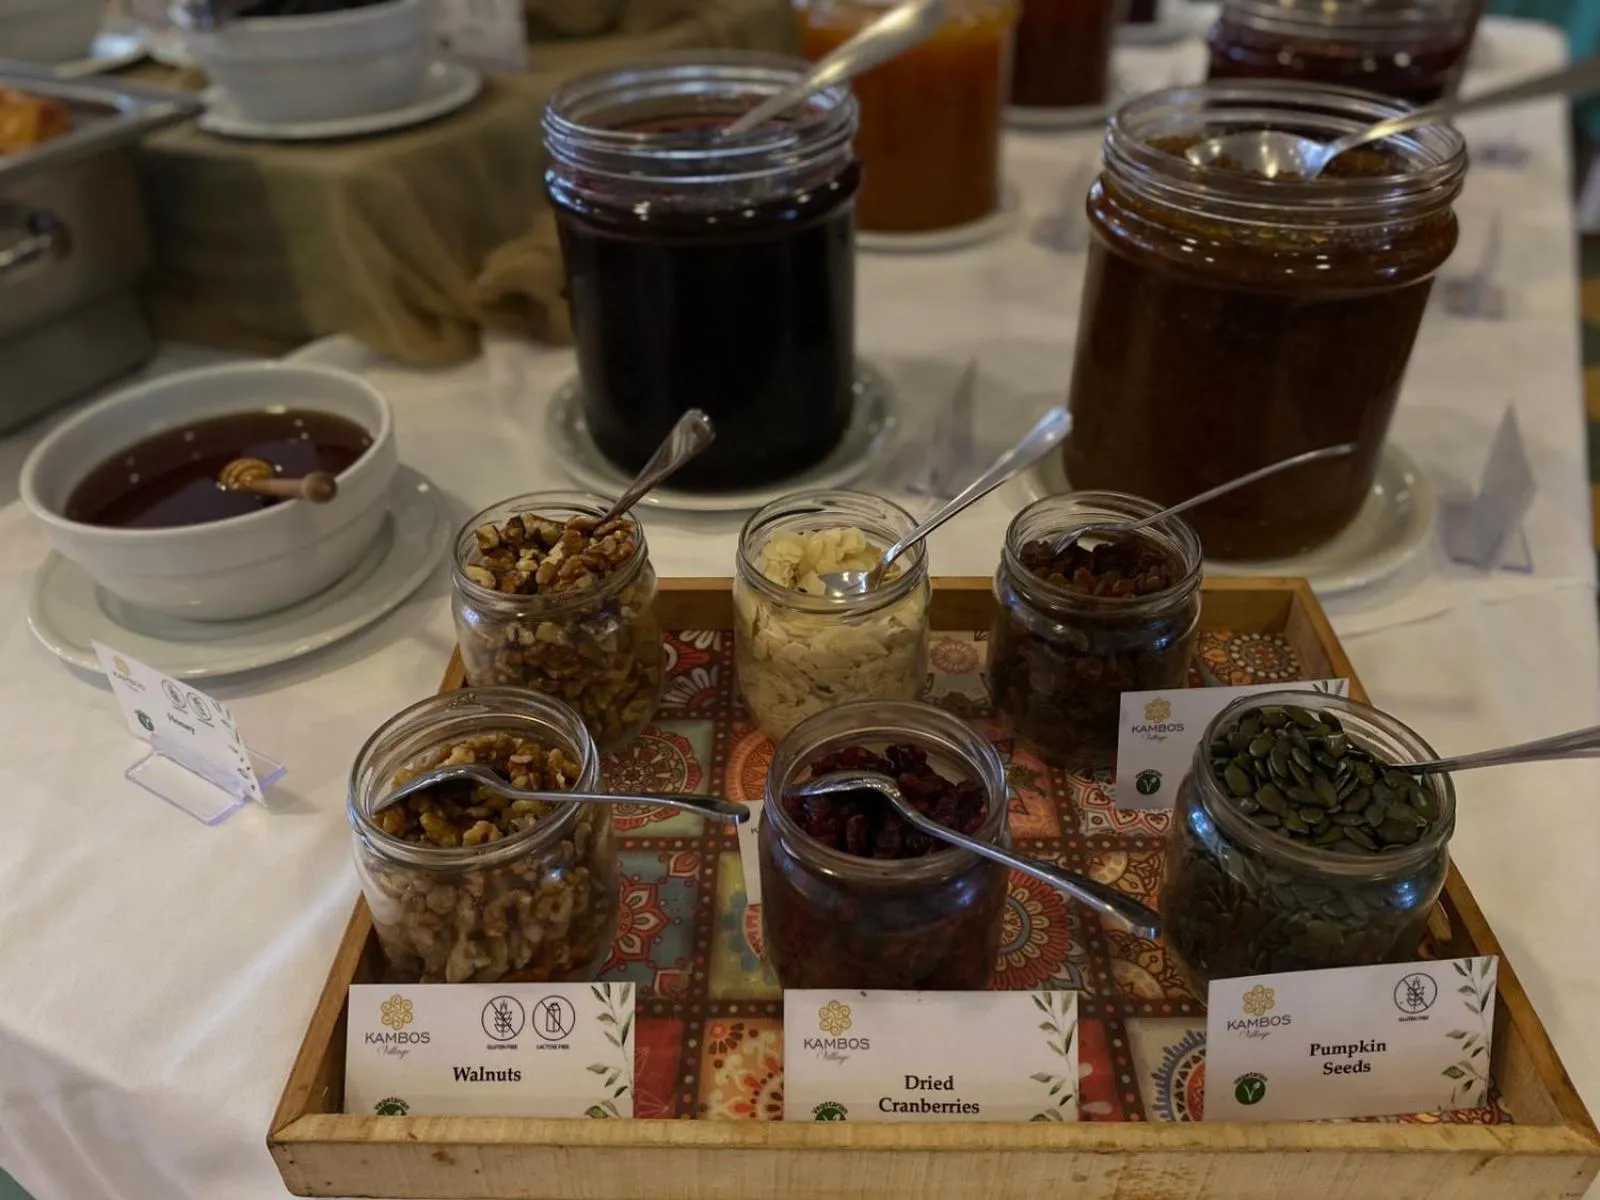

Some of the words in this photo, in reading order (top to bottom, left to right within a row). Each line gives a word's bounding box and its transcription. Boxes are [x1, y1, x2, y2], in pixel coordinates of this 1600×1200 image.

[1131, 723, 1185, 734] KAMBOS
[1226, 1014, 1292, 1031] KAMBOS
[364, 1031, 431, 1044] KAMBOS
[803, 1037, 871, 1050] KAMBOS
[1309, 1039, 1387, 1058] Pumpkin
[453, 1065, 522, 1082] Walnuts
[1322, 1059, 1372, 1075] Seeds
[904, 1074, 955, 1091] Dried
[878, 1096, 980, 1115] Cranberries
